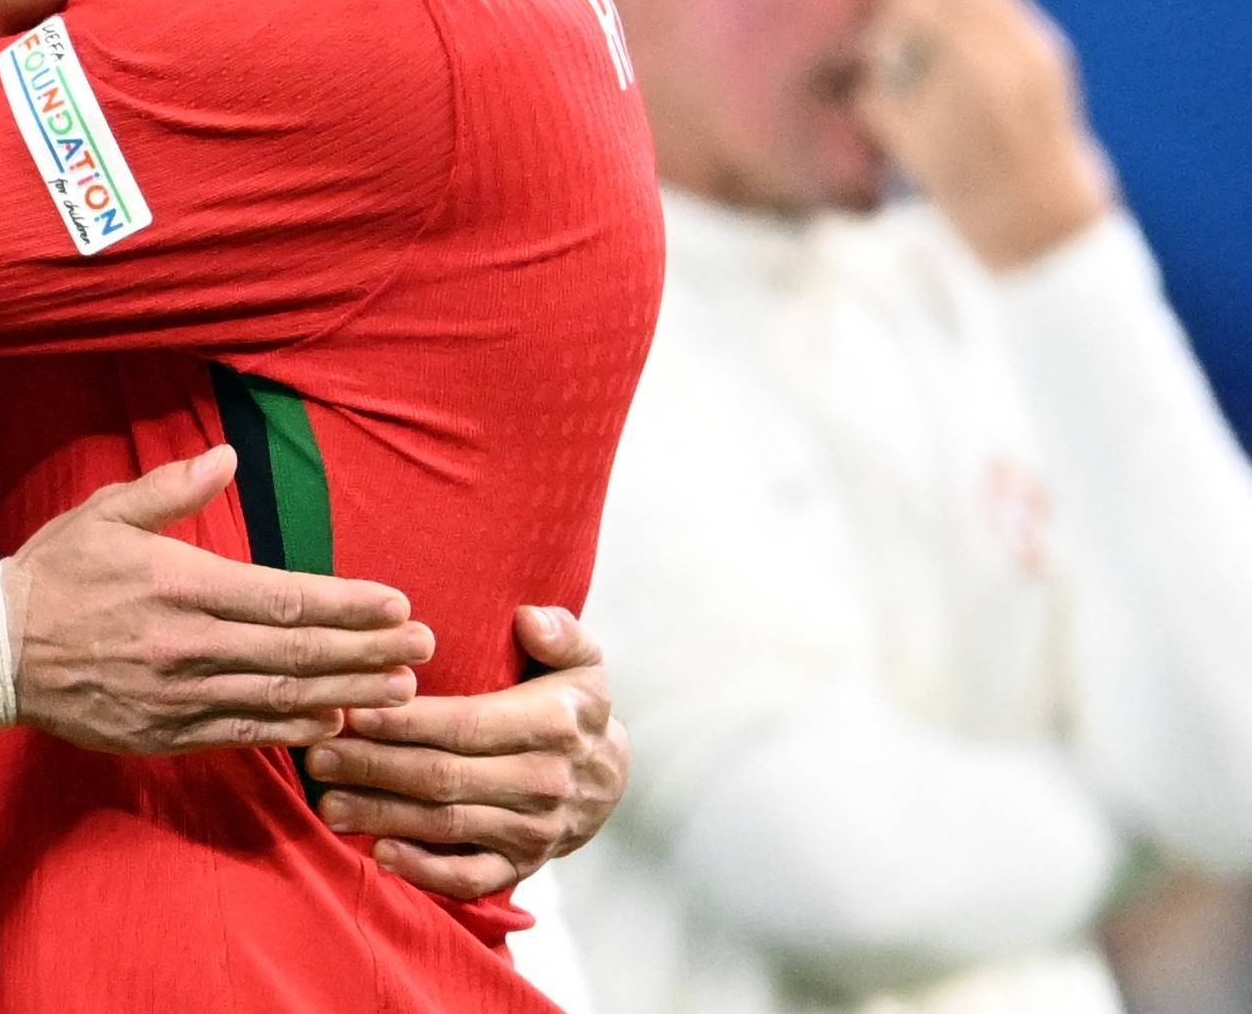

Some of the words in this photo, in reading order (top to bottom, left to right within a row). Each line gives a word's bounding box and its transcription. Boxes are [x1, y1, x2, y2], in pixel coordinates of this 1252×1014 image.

[42, 24, 65, 62] UEFA
[20, 34, 124, 236] FOUNDATION
[48, 178, 68, 195] for
[63, 199, 90, 246] children
